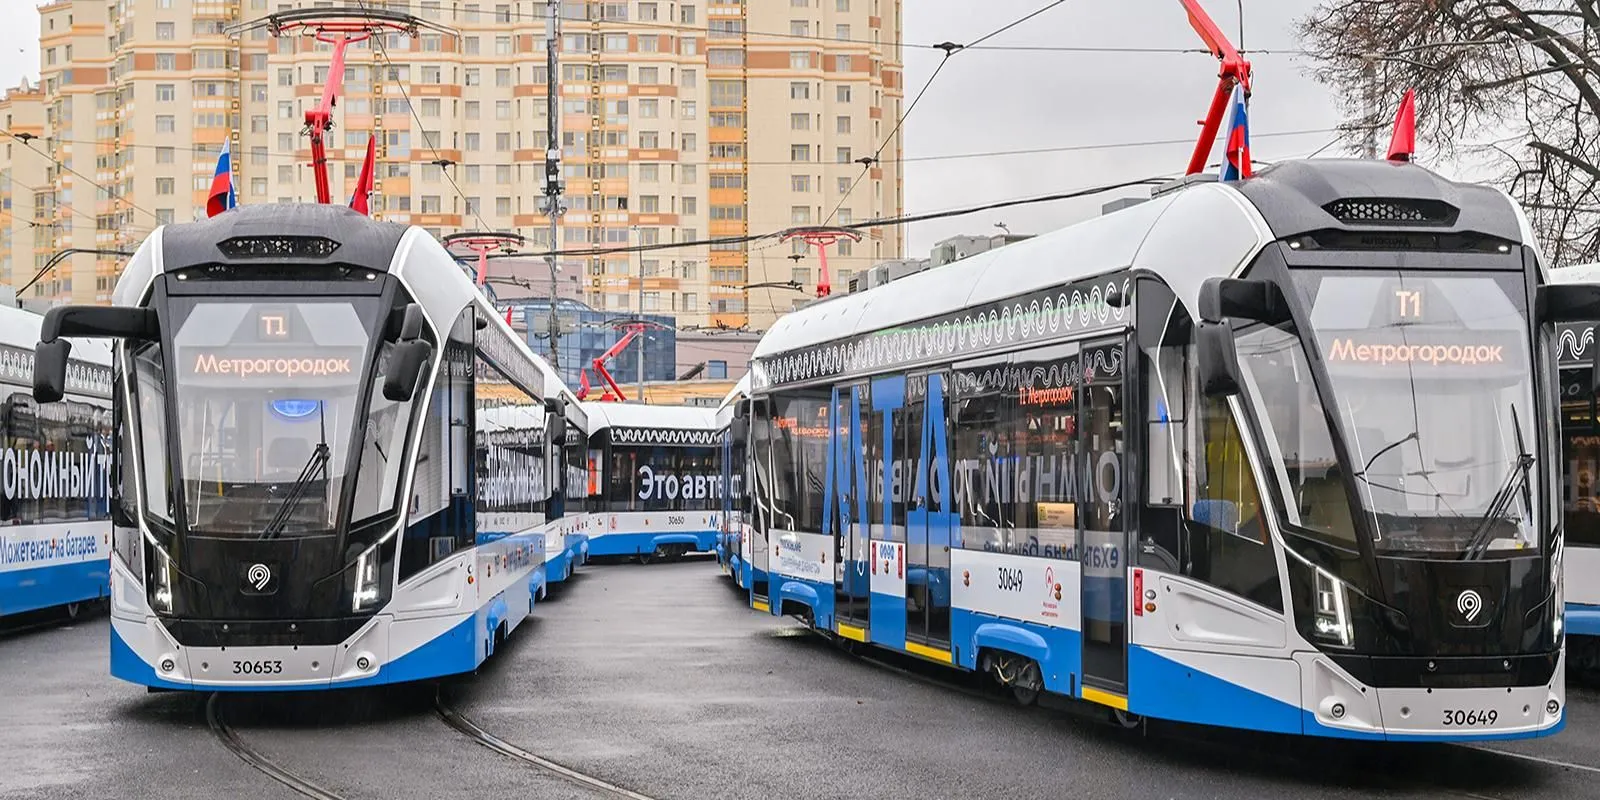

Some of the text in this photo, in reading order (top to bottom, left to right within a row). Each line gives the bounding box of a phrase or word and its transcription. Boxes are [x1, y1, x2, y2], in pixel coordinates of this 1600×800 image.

[1395, 290, 1421, 317] Т1
[261, 316, 287, 335] Т1
[1328, 338, 1503, 366] Метрогородок
[194, 354, 350, 378] Метрогородок
[0, 436, 96, 500] ономный
[638, 465, 680, 500] Это
[56, 536, 65, 557] на
[66, 528, 98, 560] батарее.
[997, 567, 1023, 592] 30649
[232, 660, 283, 674] 30653
[1442, 709, 1498, 726] 30649
